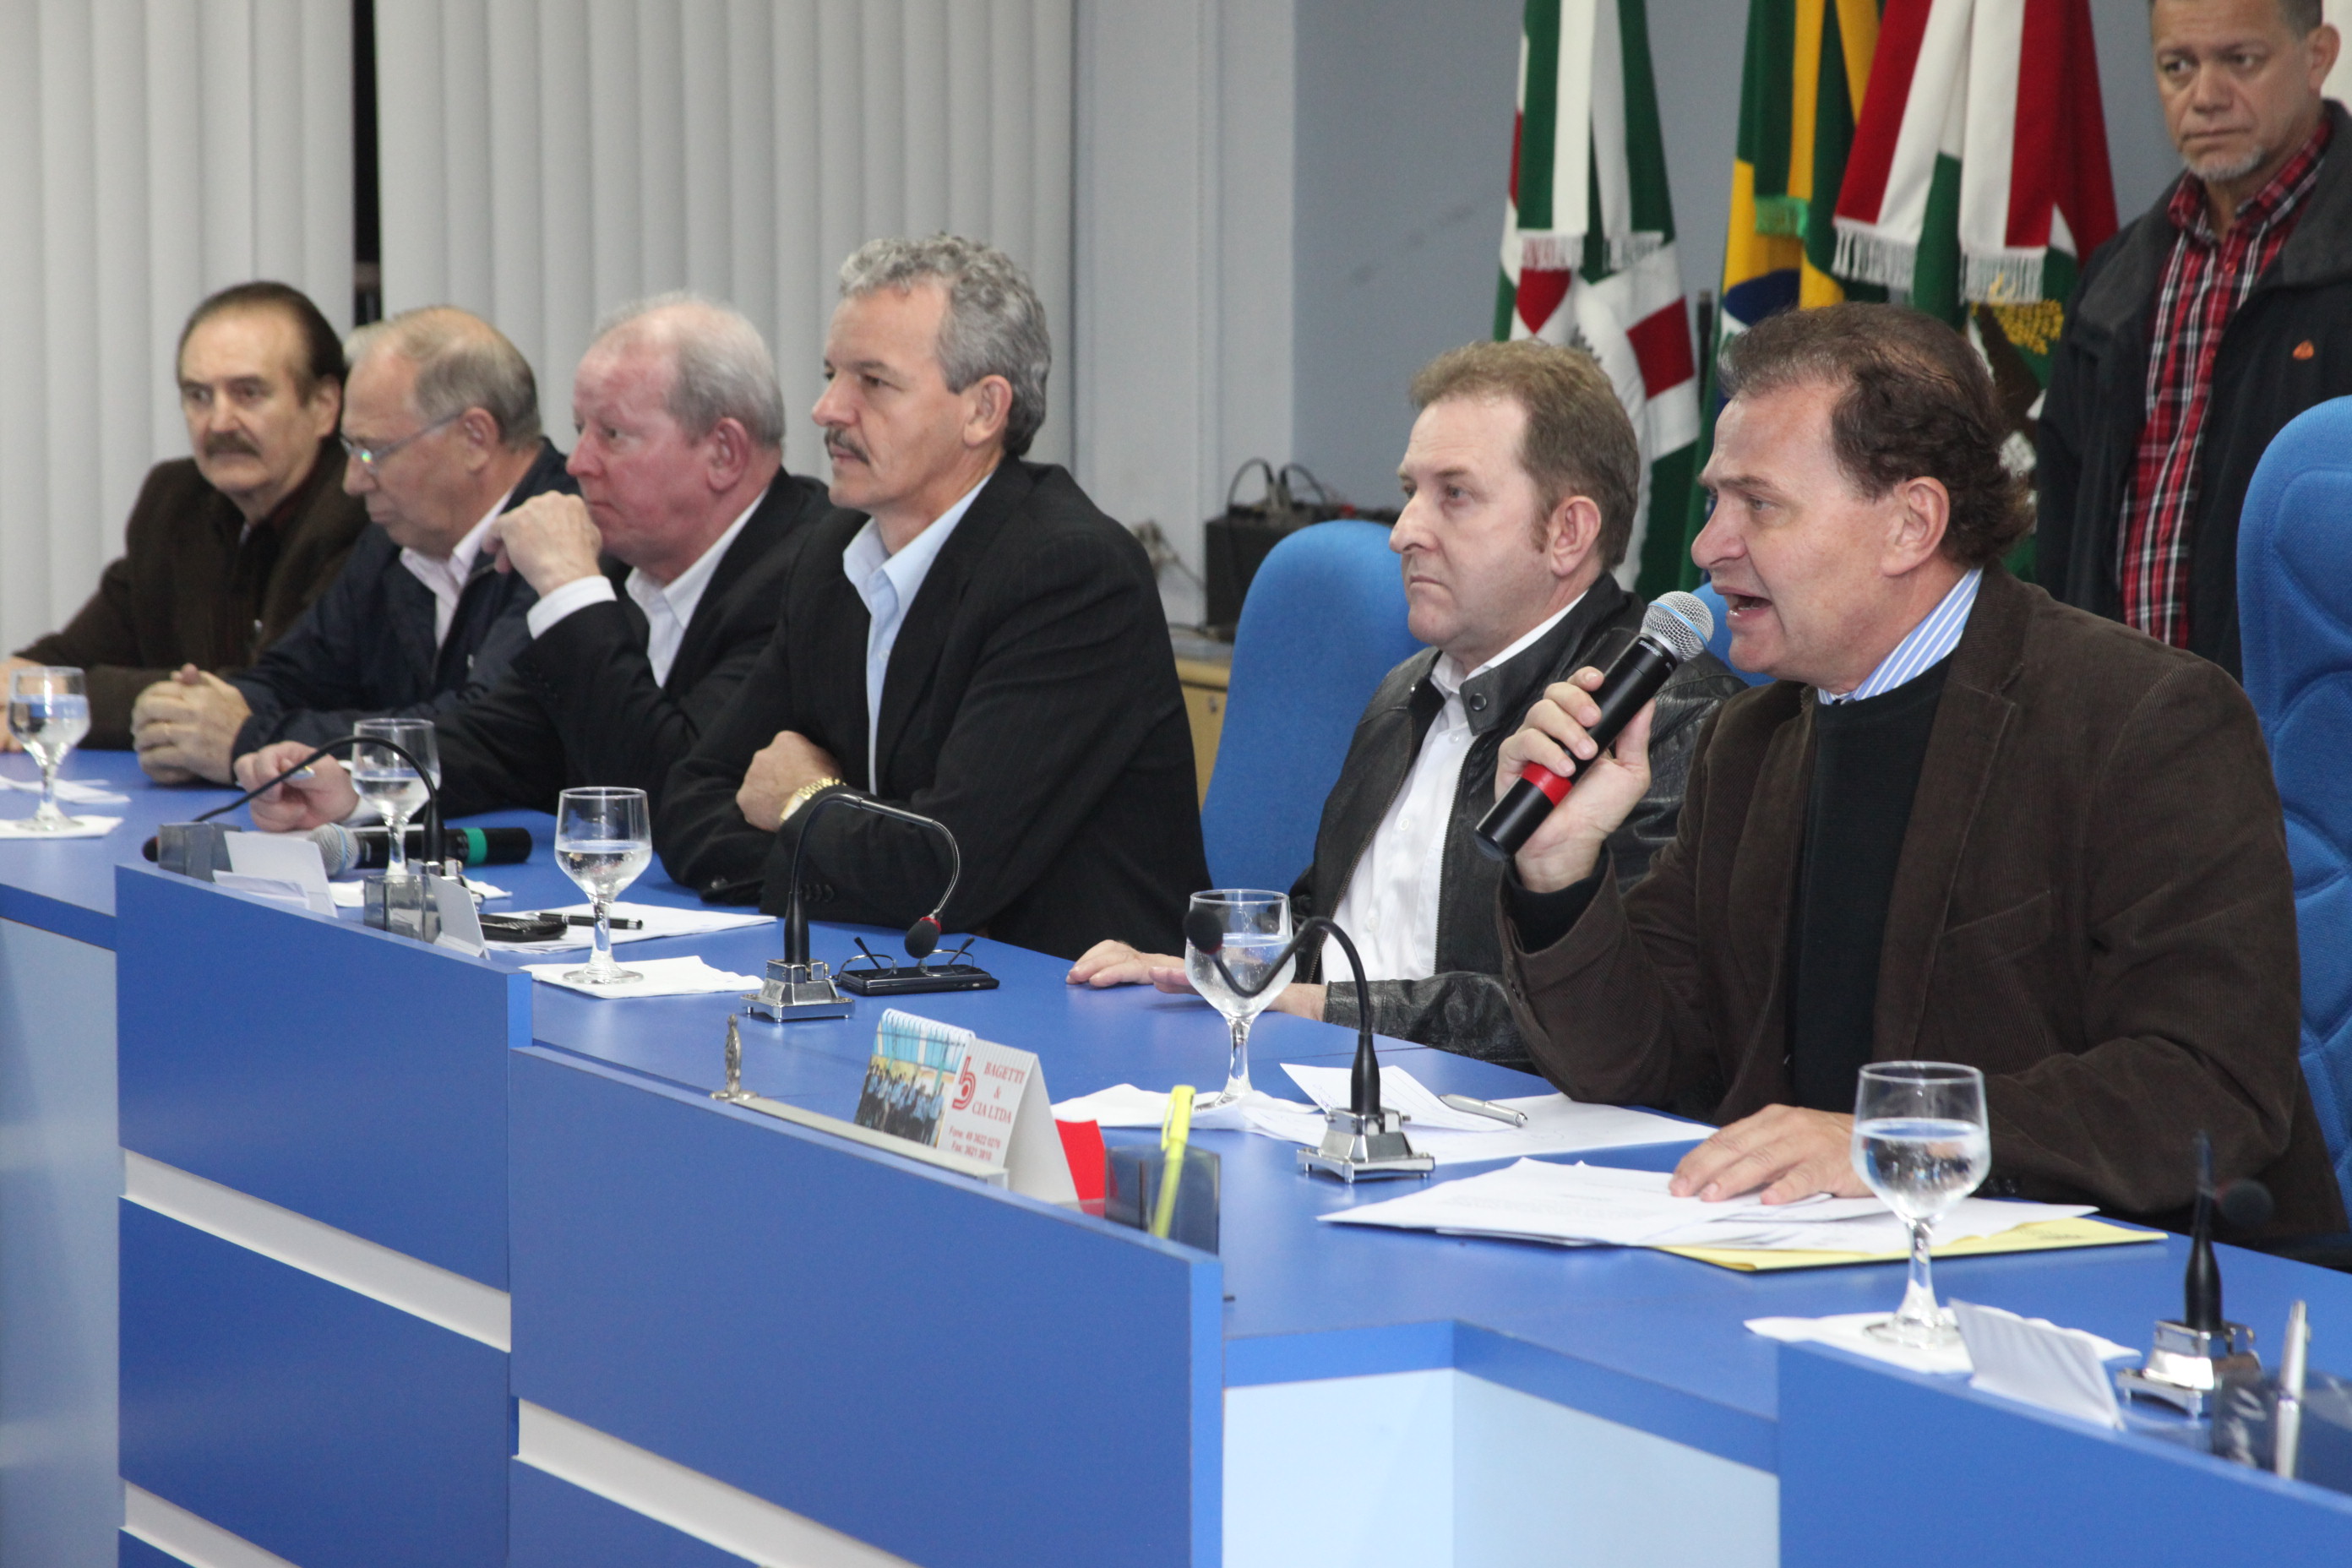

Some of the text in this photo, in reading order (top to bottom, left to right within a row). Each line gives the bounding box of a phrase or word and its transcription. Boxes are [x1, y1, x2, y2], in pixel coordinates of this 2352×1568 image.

[984, 1061, 1026, 1084] BAGETTI
[994, 1086, 1001, 1099] &
[972, 1101, 1012, 1124] CIA LTDA
